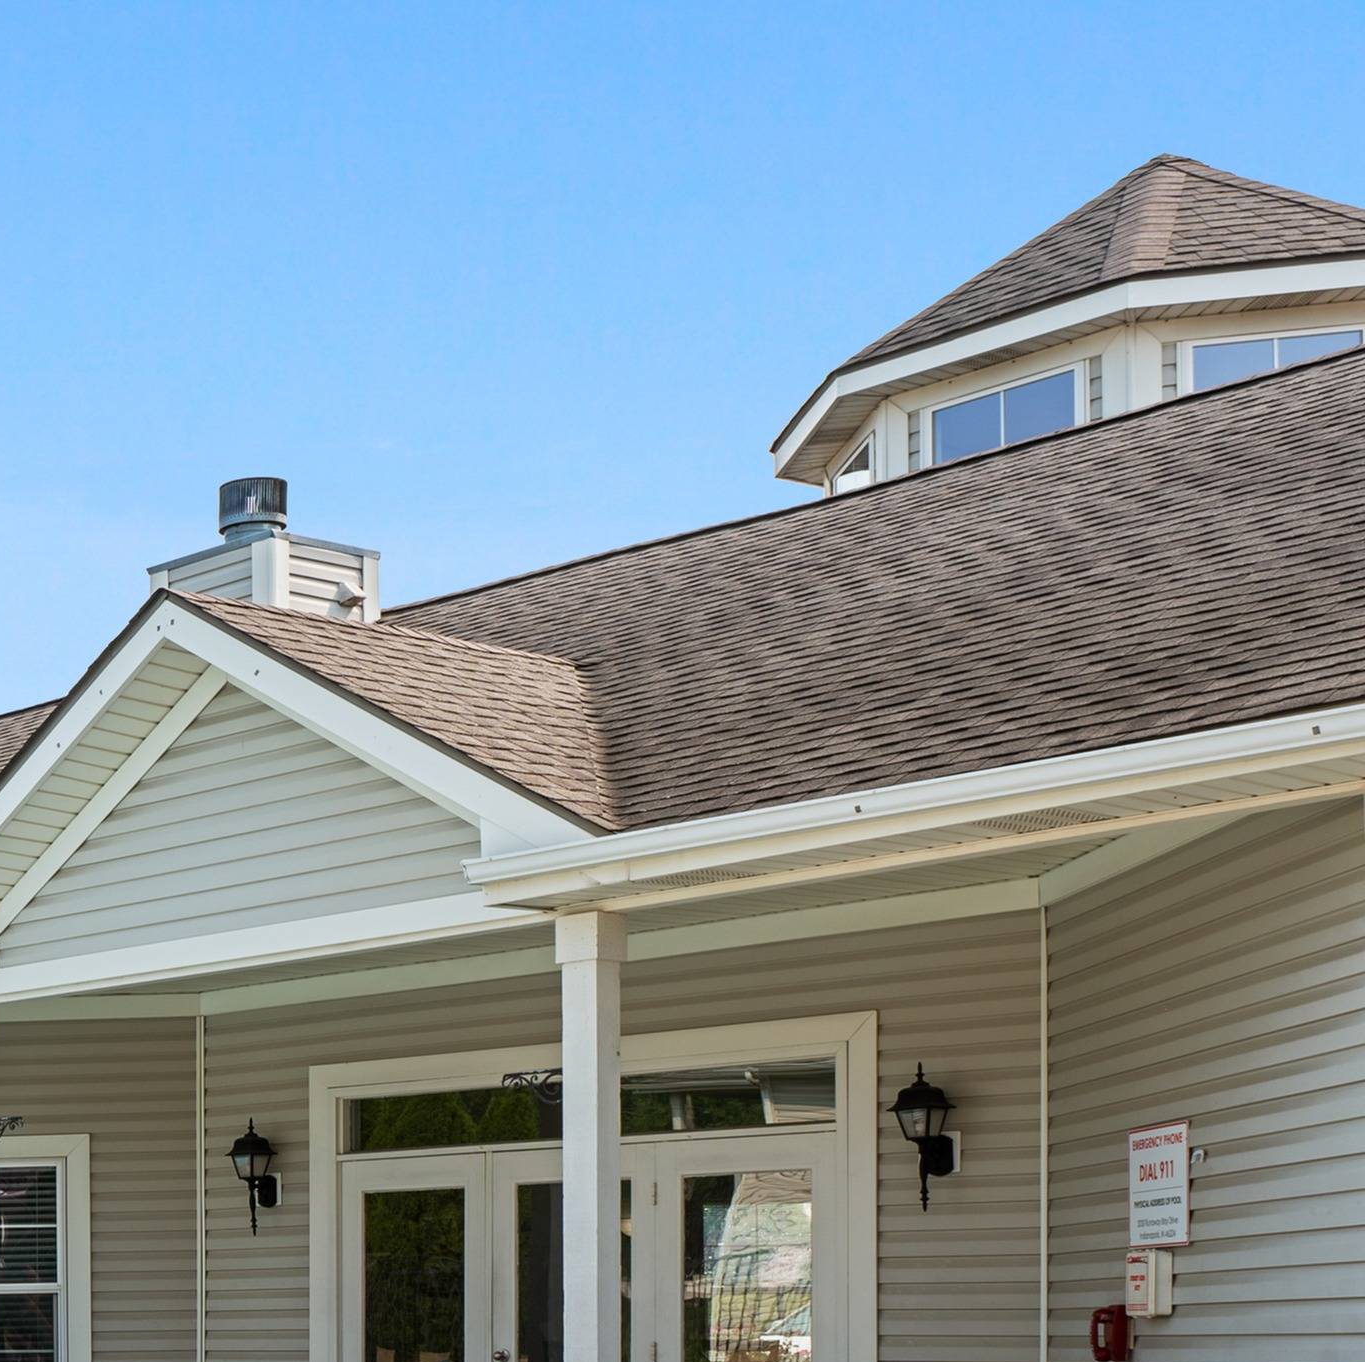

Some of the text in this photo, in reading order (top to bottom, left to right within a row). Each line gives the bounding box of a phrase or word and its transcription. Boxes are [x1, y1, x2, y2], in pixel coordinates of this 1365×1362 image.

[1132, 1132, 1183, 1151] EMERGENCY PHONE
[1139, 1160, 1174, 1182] DIAL 911
